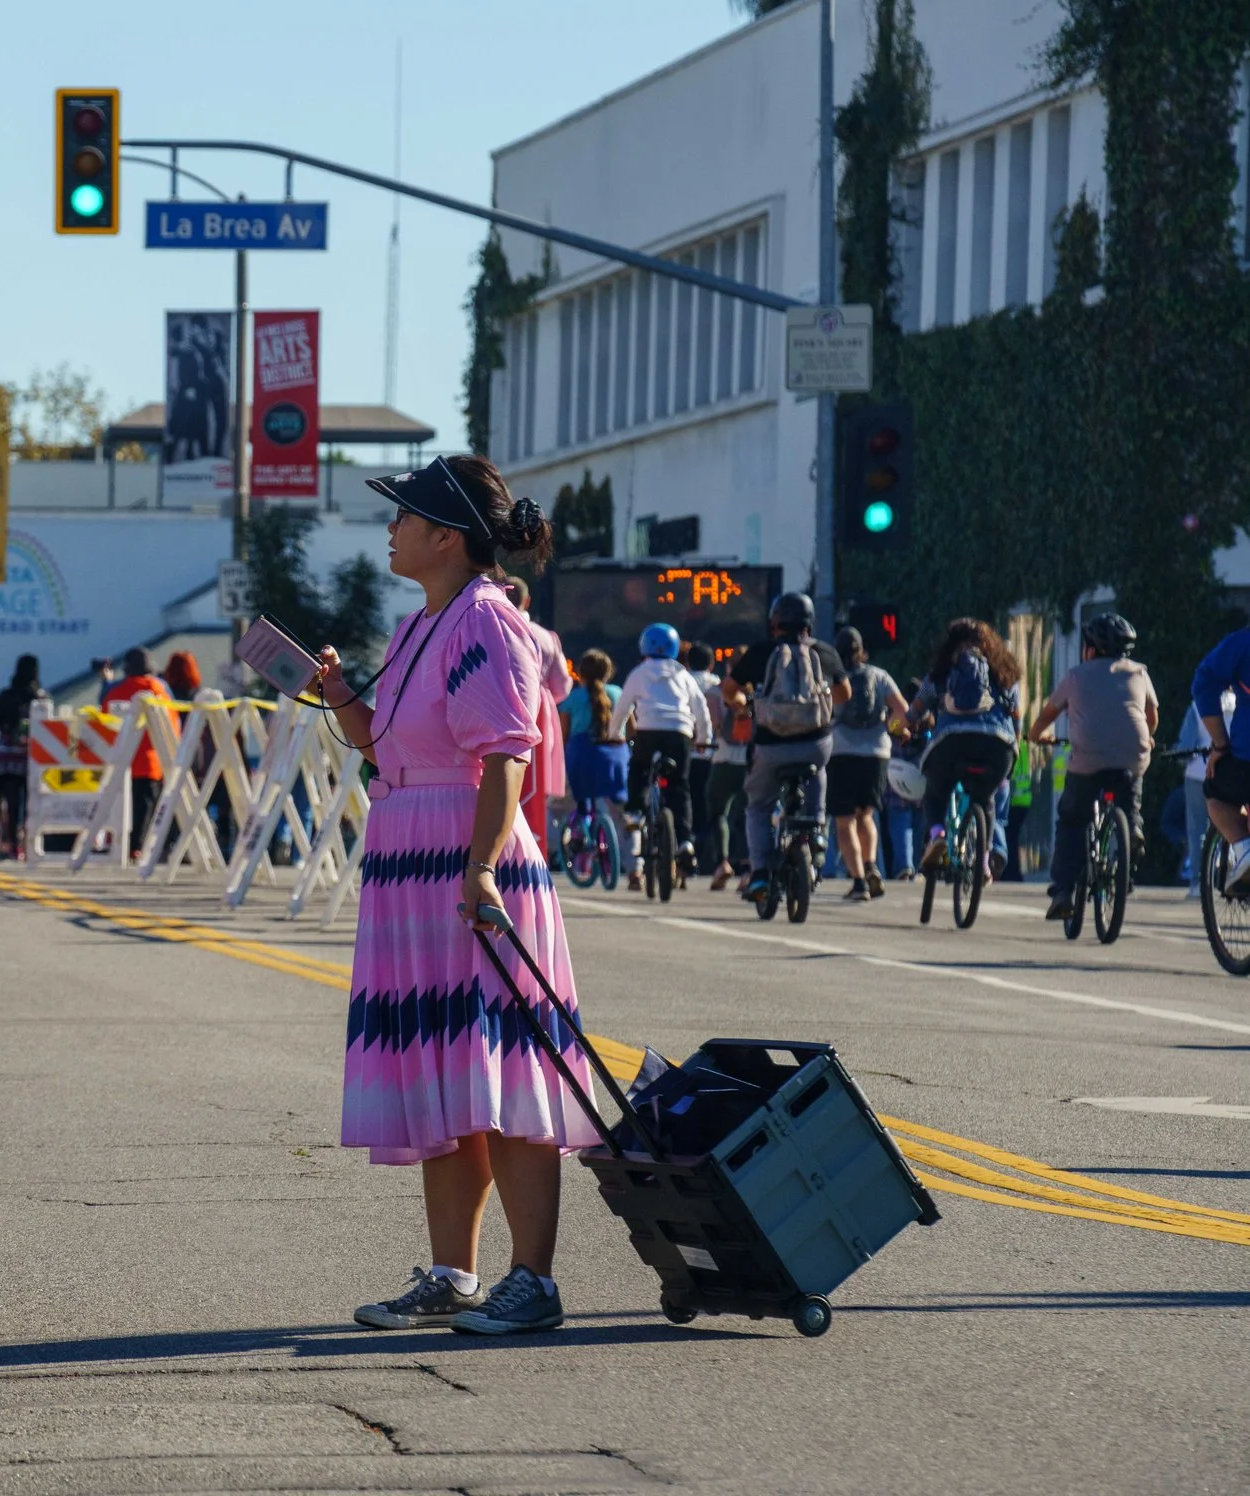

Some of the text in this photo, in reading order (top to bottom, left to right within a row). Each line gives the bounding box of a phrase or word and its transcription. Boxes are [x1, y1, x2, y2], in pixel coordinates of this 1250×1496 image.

[160, 212, 312, 240] La Brea Av
[259, 332, 313, 365] ARTS
[37, 619, 90, 635] START
[882, 613, 896, 641] 4
